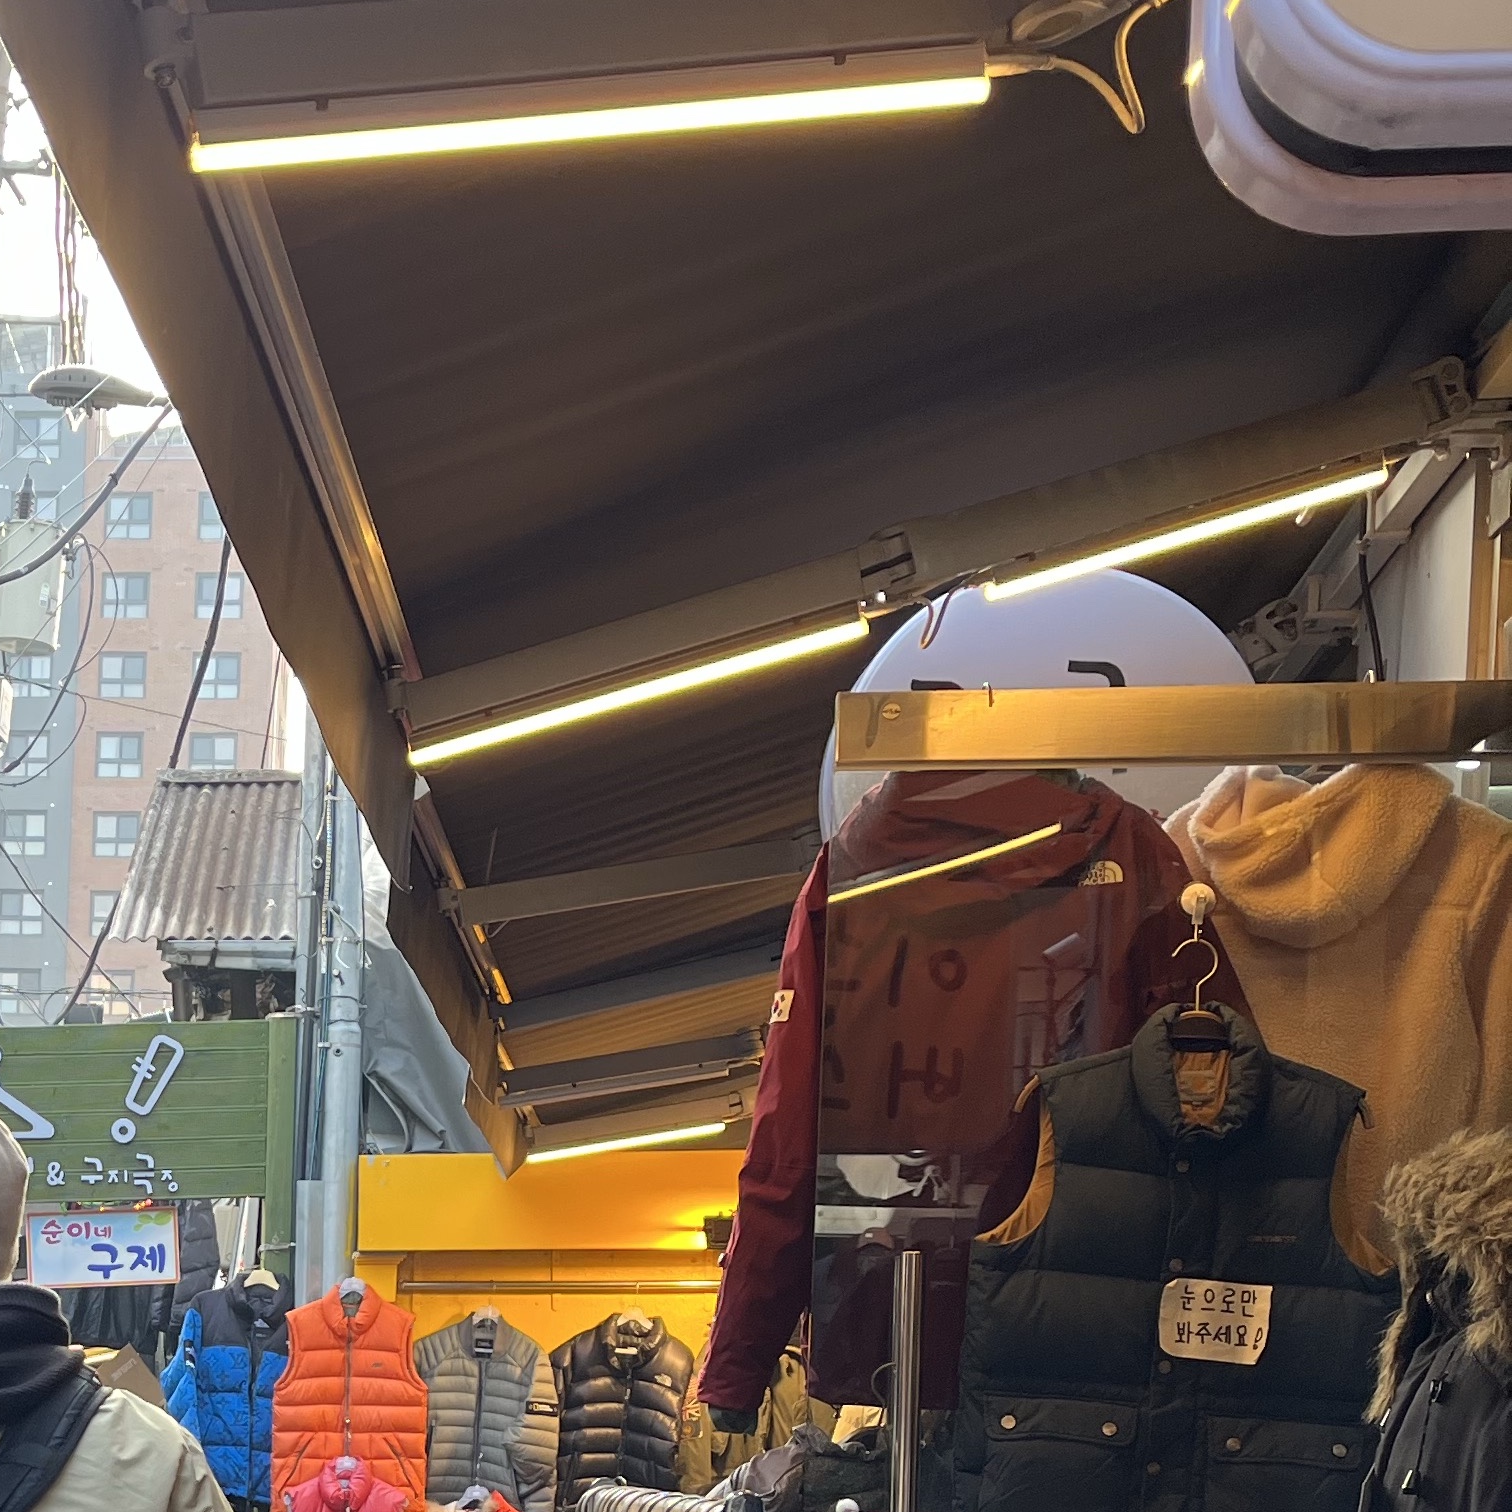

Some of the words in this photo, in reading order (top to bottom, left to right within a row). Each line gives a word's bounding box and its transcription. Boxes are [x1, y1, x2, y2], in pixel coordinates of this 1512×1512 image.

[46, 1161, 66, 1187] &
[40, 1219, 112, 1245] 순이네
[87, 1242, 166, 1279] 구제
[1179, 1284, 1258, 1318] 눈으로만
[1174, 1321, 1264, 1350] 봐주세요!
